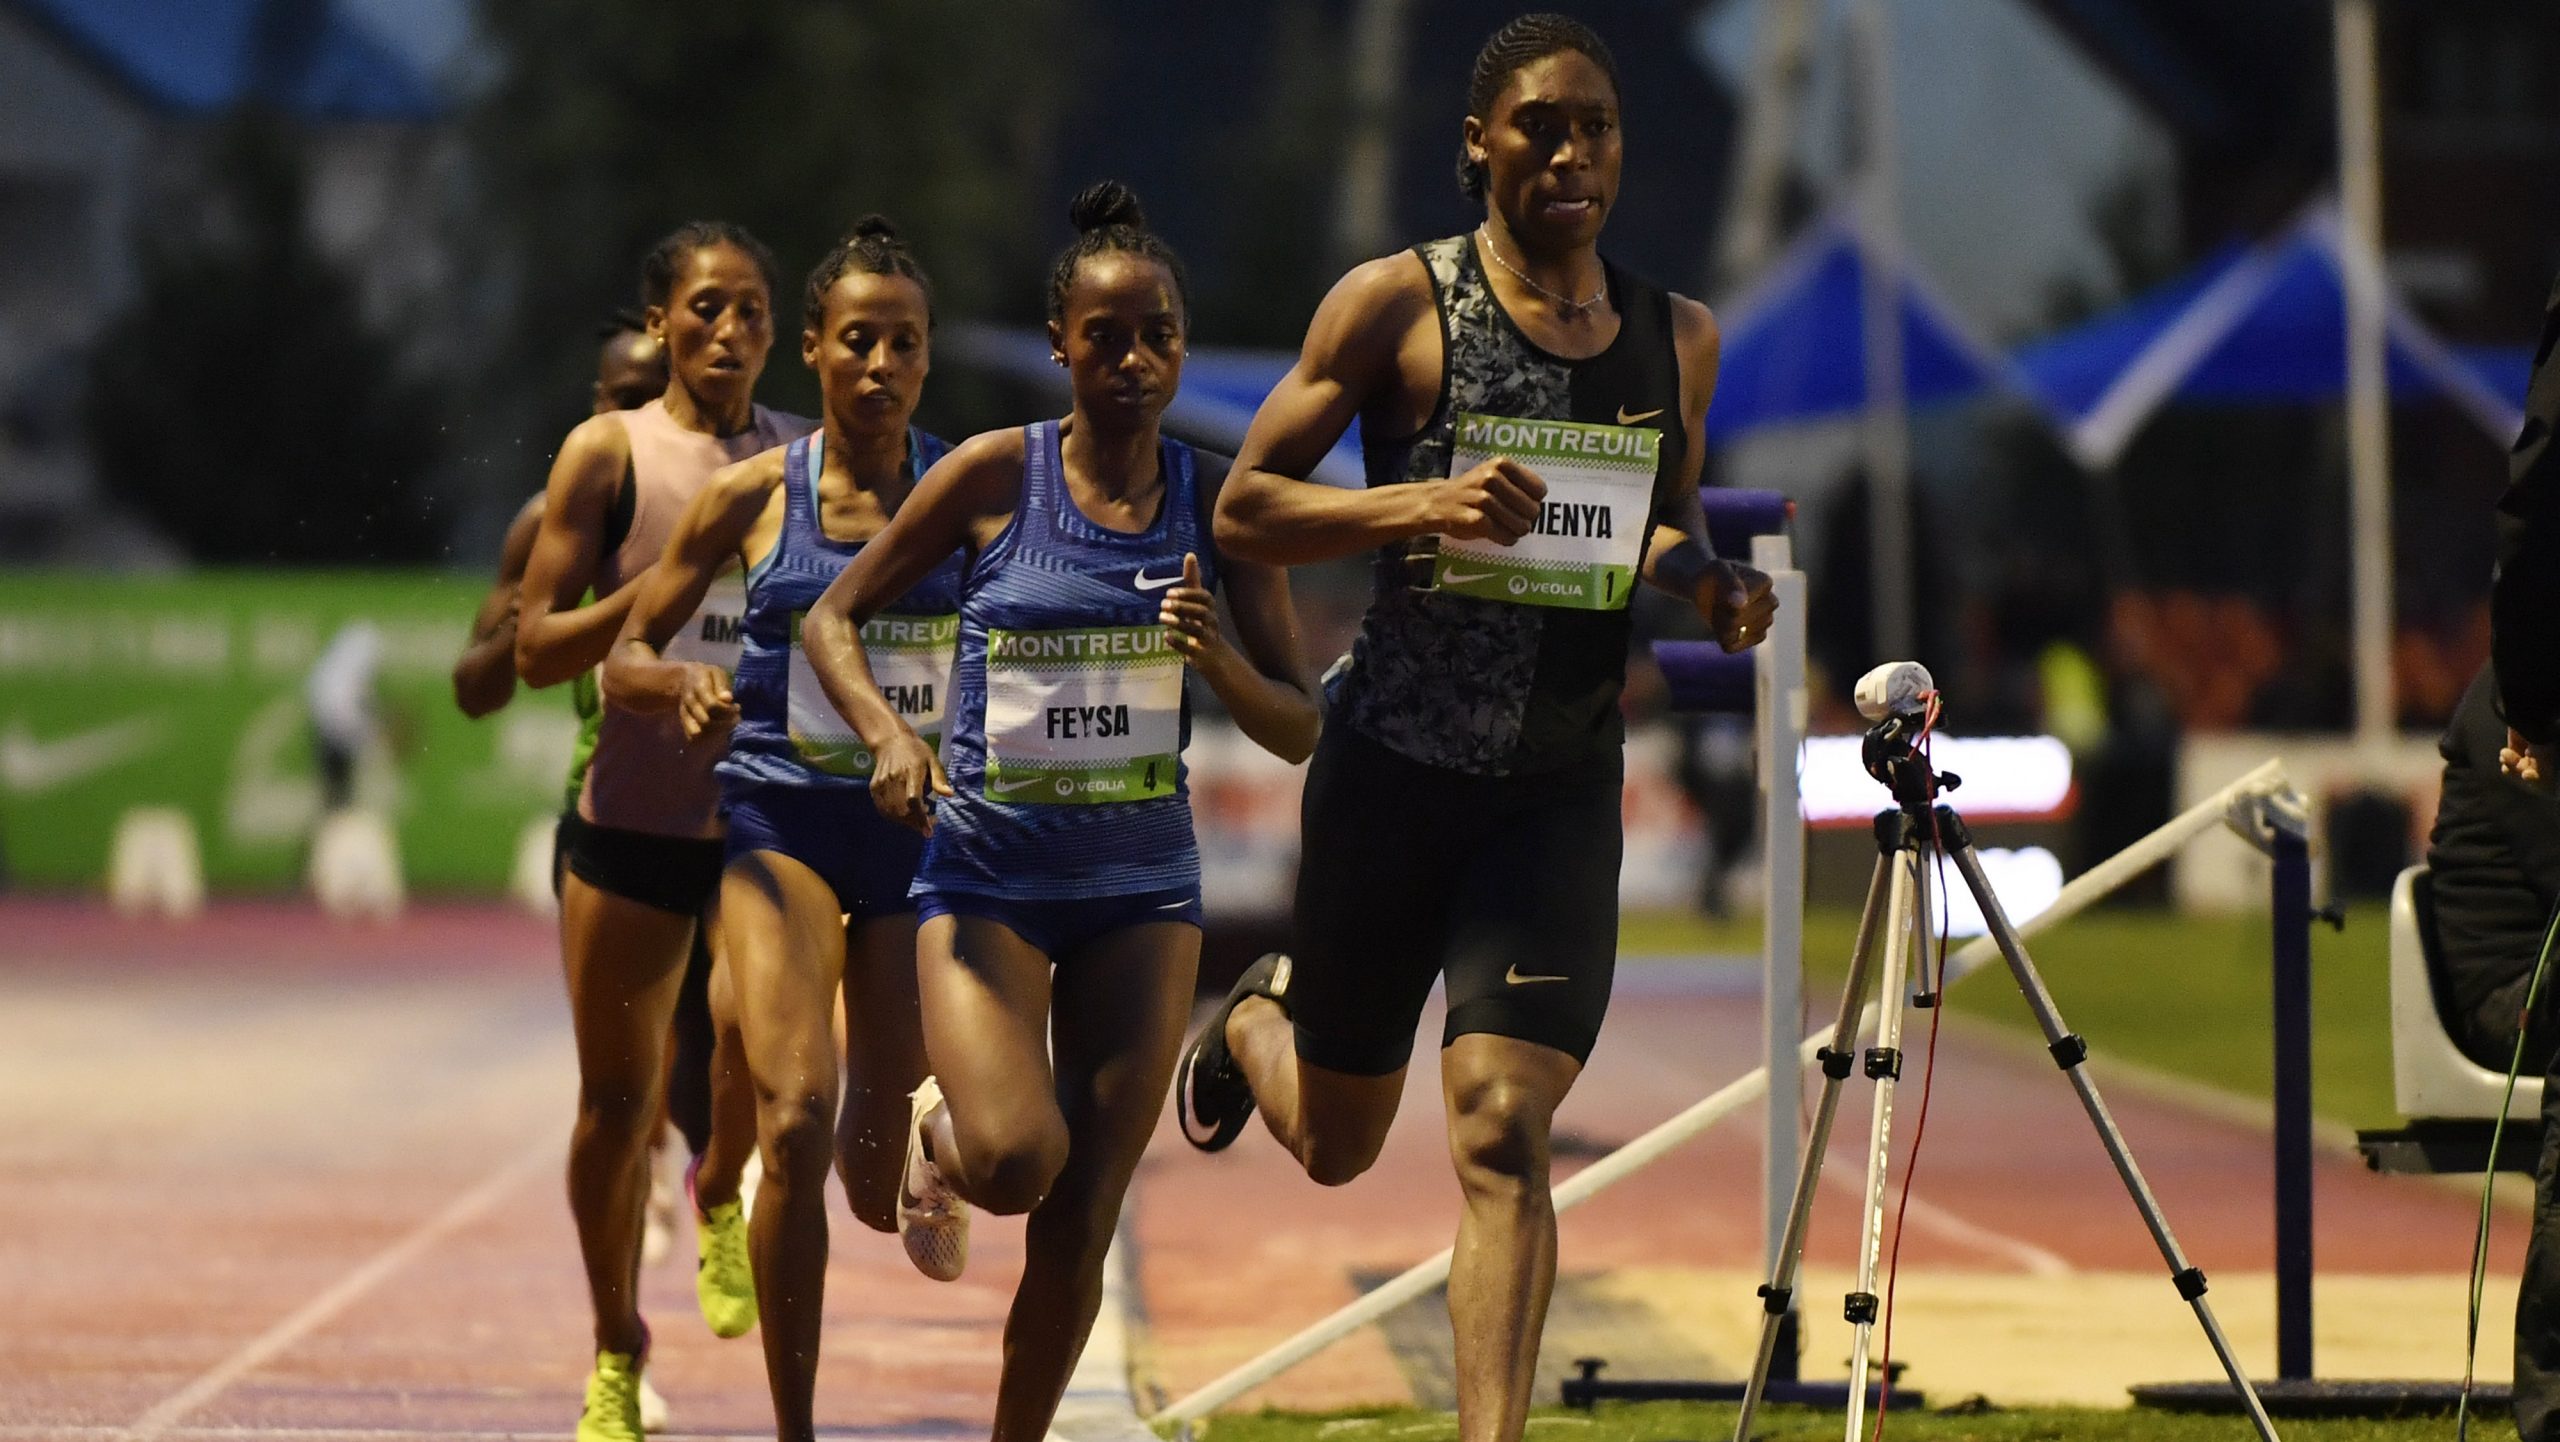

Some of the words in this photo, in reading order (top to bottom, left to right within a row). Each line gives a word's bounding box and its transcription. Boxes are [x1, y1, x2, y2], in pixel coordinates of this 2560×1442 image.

[1465, 421, 1651, 458] MONTREUIL
[1529, 502, 1612, 539] ENYA
[1529, 583, 1583, 596] VEOLIA
[1605, 571, 1614, 602] 1
[701, 614, 741, 644] AM
[878, 684, 933, 714] EMA
[1046, 705, 1130, 739] FEYSA
[1076, 780, 1126, 792] VEOLIA
[1143, 762, 1160, 792] 4
